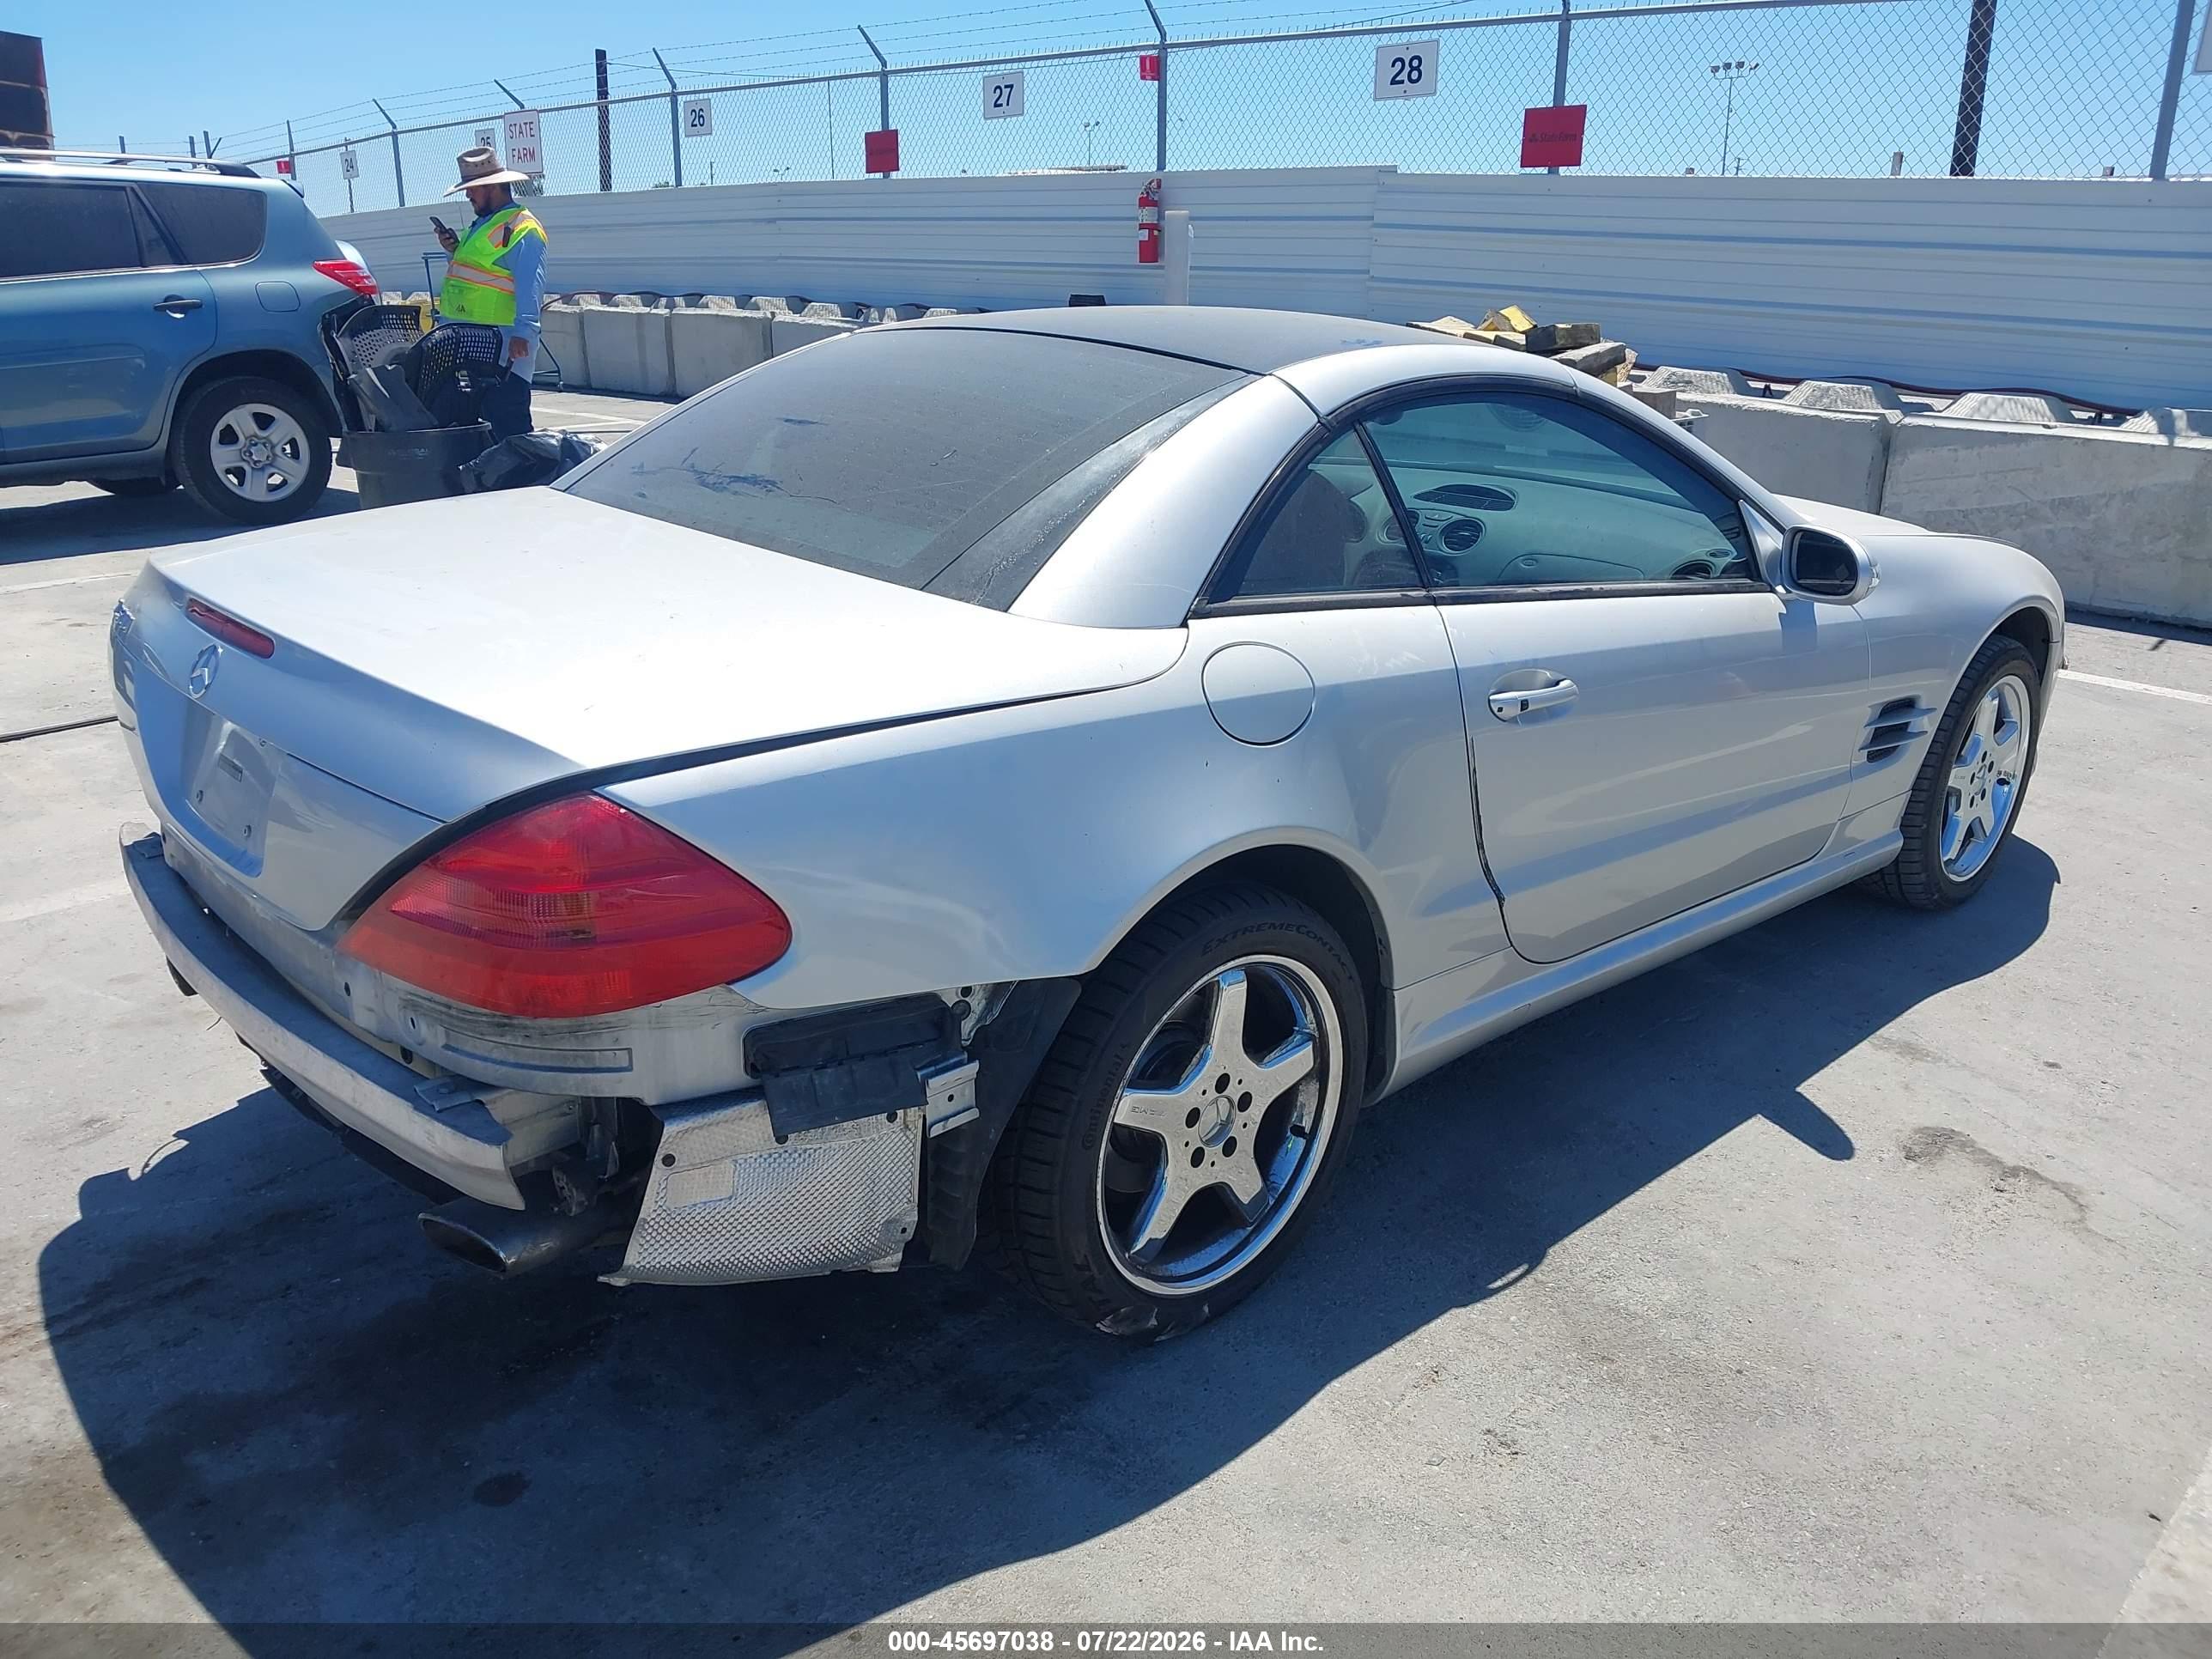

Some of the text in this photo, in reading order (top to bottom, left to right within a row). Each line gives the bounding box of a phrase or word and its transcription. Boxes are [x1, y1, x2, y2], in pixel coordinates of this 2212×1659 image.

[1389, 54, 1423, 86] 28
[993, 83, 1015, 108] 27
[690, 107, 706, 128] 26
[508, 120, 536, 140] STATE
[344, 157, 355, 173] 24
[511, 146, 537, 164] FARM
